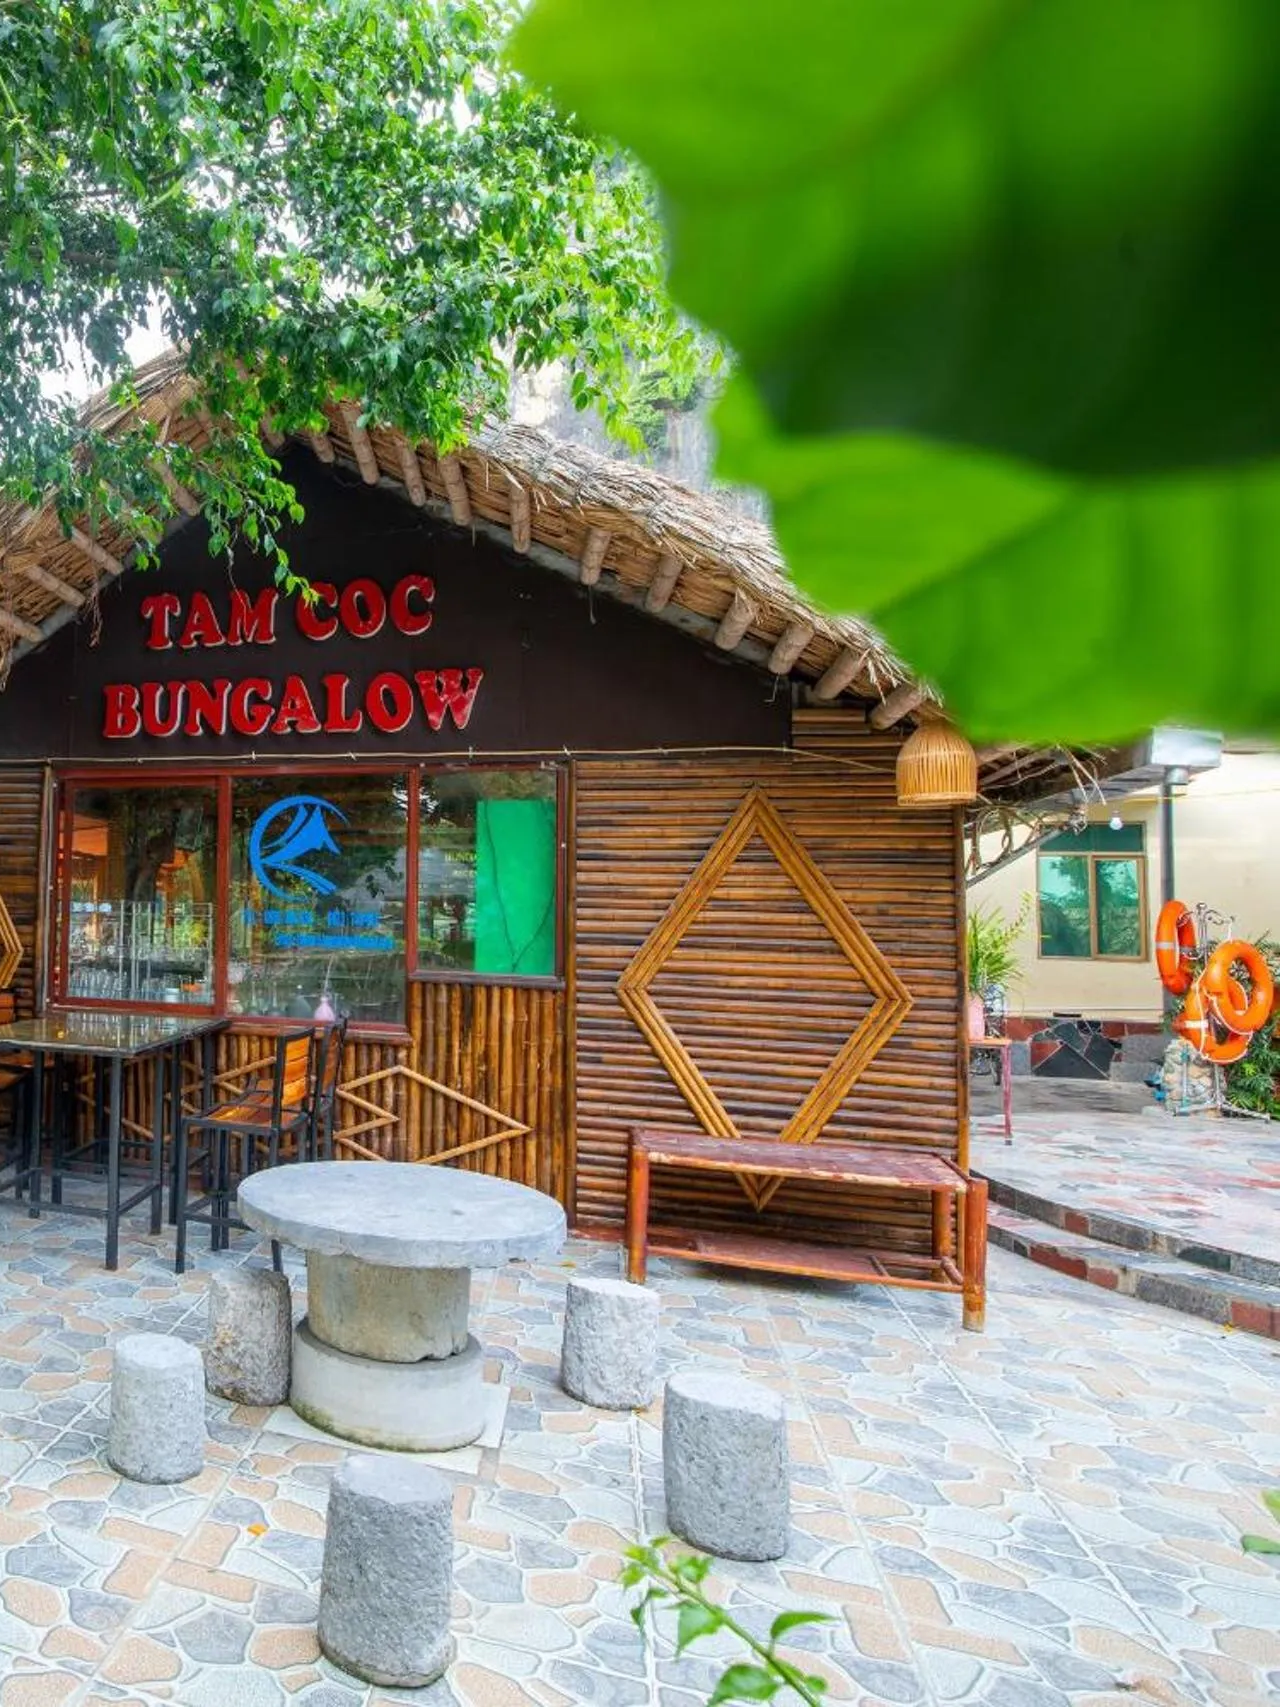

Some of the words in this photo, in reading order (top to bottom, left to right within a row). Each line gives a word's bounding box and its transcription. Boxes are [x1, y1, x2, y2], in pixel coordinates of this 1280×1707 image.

[141, 587, 279, 650] TAM
[295, 574, 435, 641] COC
[102, 667, 484, 739] BUNGALOW
